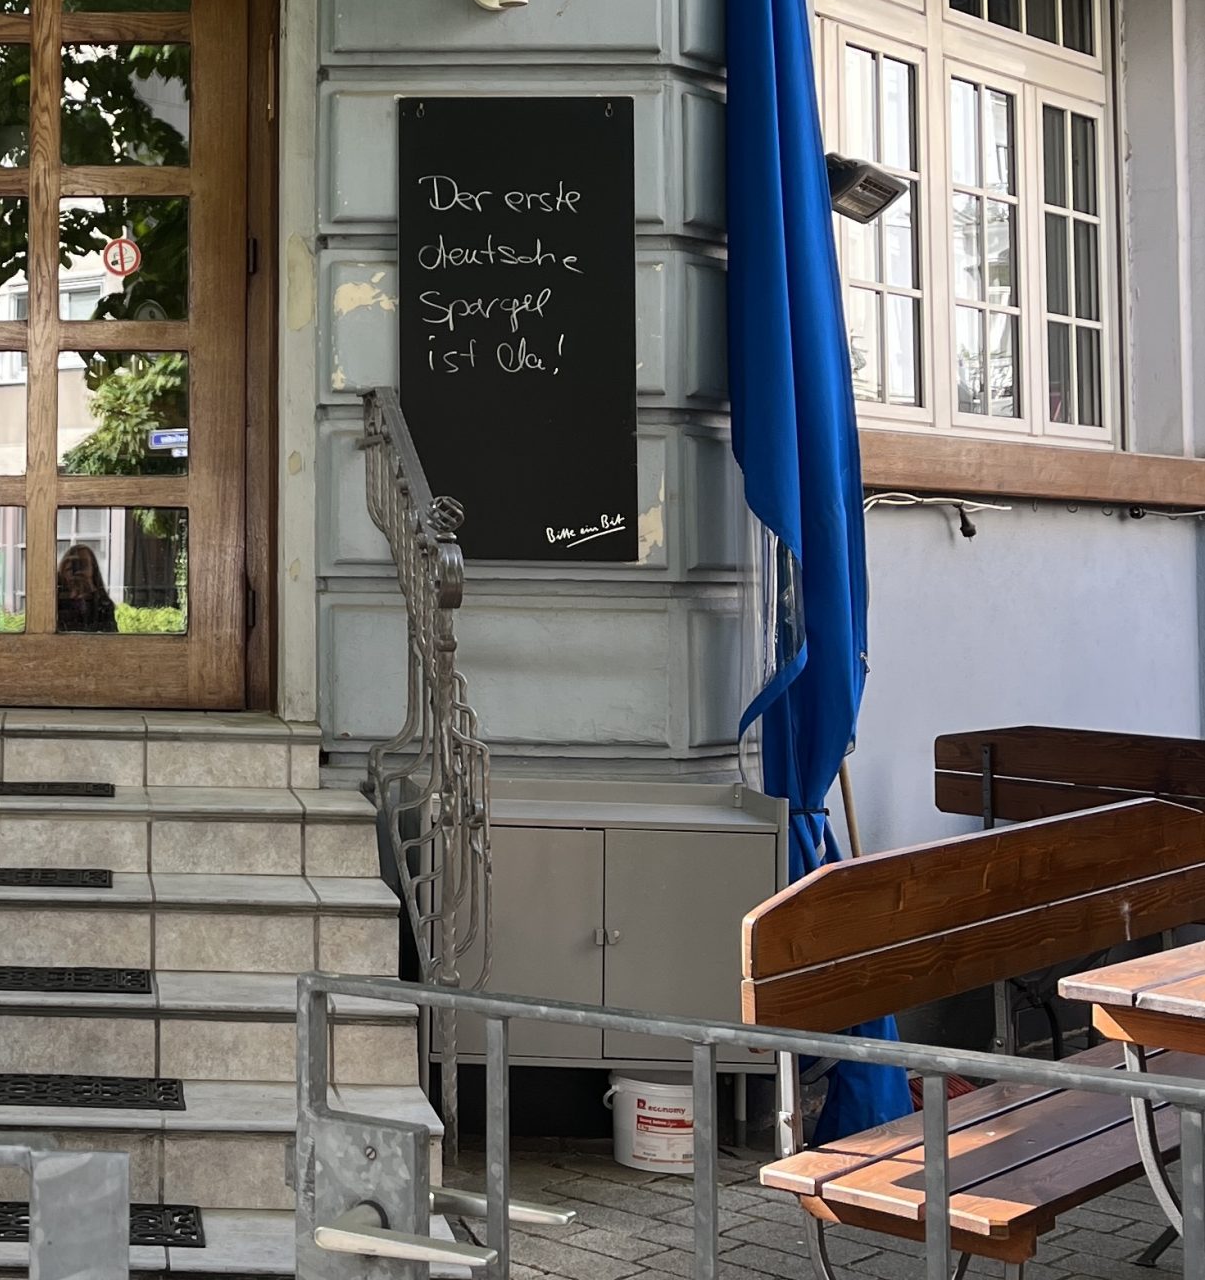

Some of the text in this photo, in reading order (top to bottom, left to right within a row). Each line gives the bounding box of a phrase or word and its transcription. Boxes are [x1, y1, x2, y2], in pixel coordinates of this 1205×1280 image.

[418, 175, 581, 213] Der erste
[418, 234, 584, 274] deutsche
[419, 287, 552, 332] Spargel
[428, 333, 565, 376] ist da!
[546, 513, 625, 543] Bitte ein Bit
